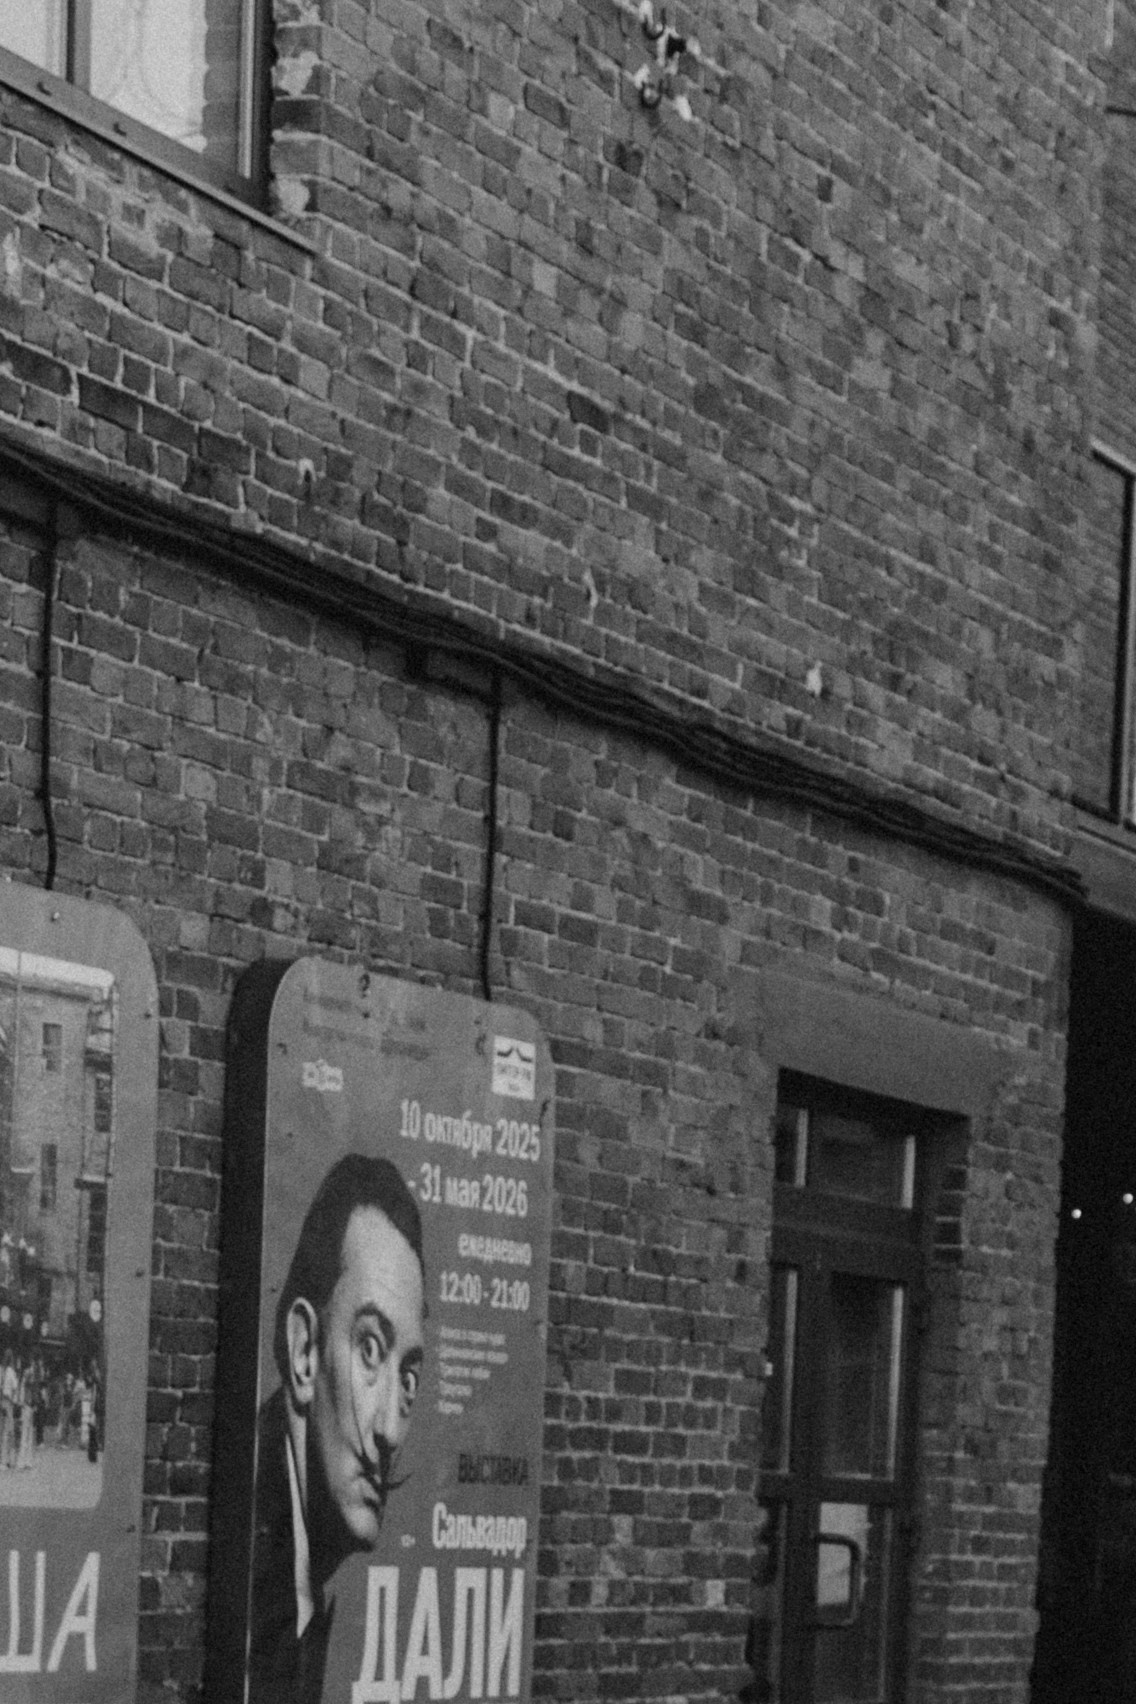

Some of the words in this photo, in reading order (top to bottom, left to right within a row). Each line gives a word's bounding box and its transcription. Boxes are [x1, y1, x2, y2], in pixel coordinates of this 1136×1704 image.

[400, 1099, 421, 1140] 10
[424, 1110, 493, 1159] октября
[496, 1118, 540, 1162] 2025
[420, 1162, 442, 1203] 31
[445, 1177, 480, 1208] мая
[482, 1174, 528, 1218] 2026
[457, 1233, 532, 1266] ежедневно
[458, 1453, 528, 1486] ВЫСТАВКА
[433, 1502, 527, 1559] Сальвадор
